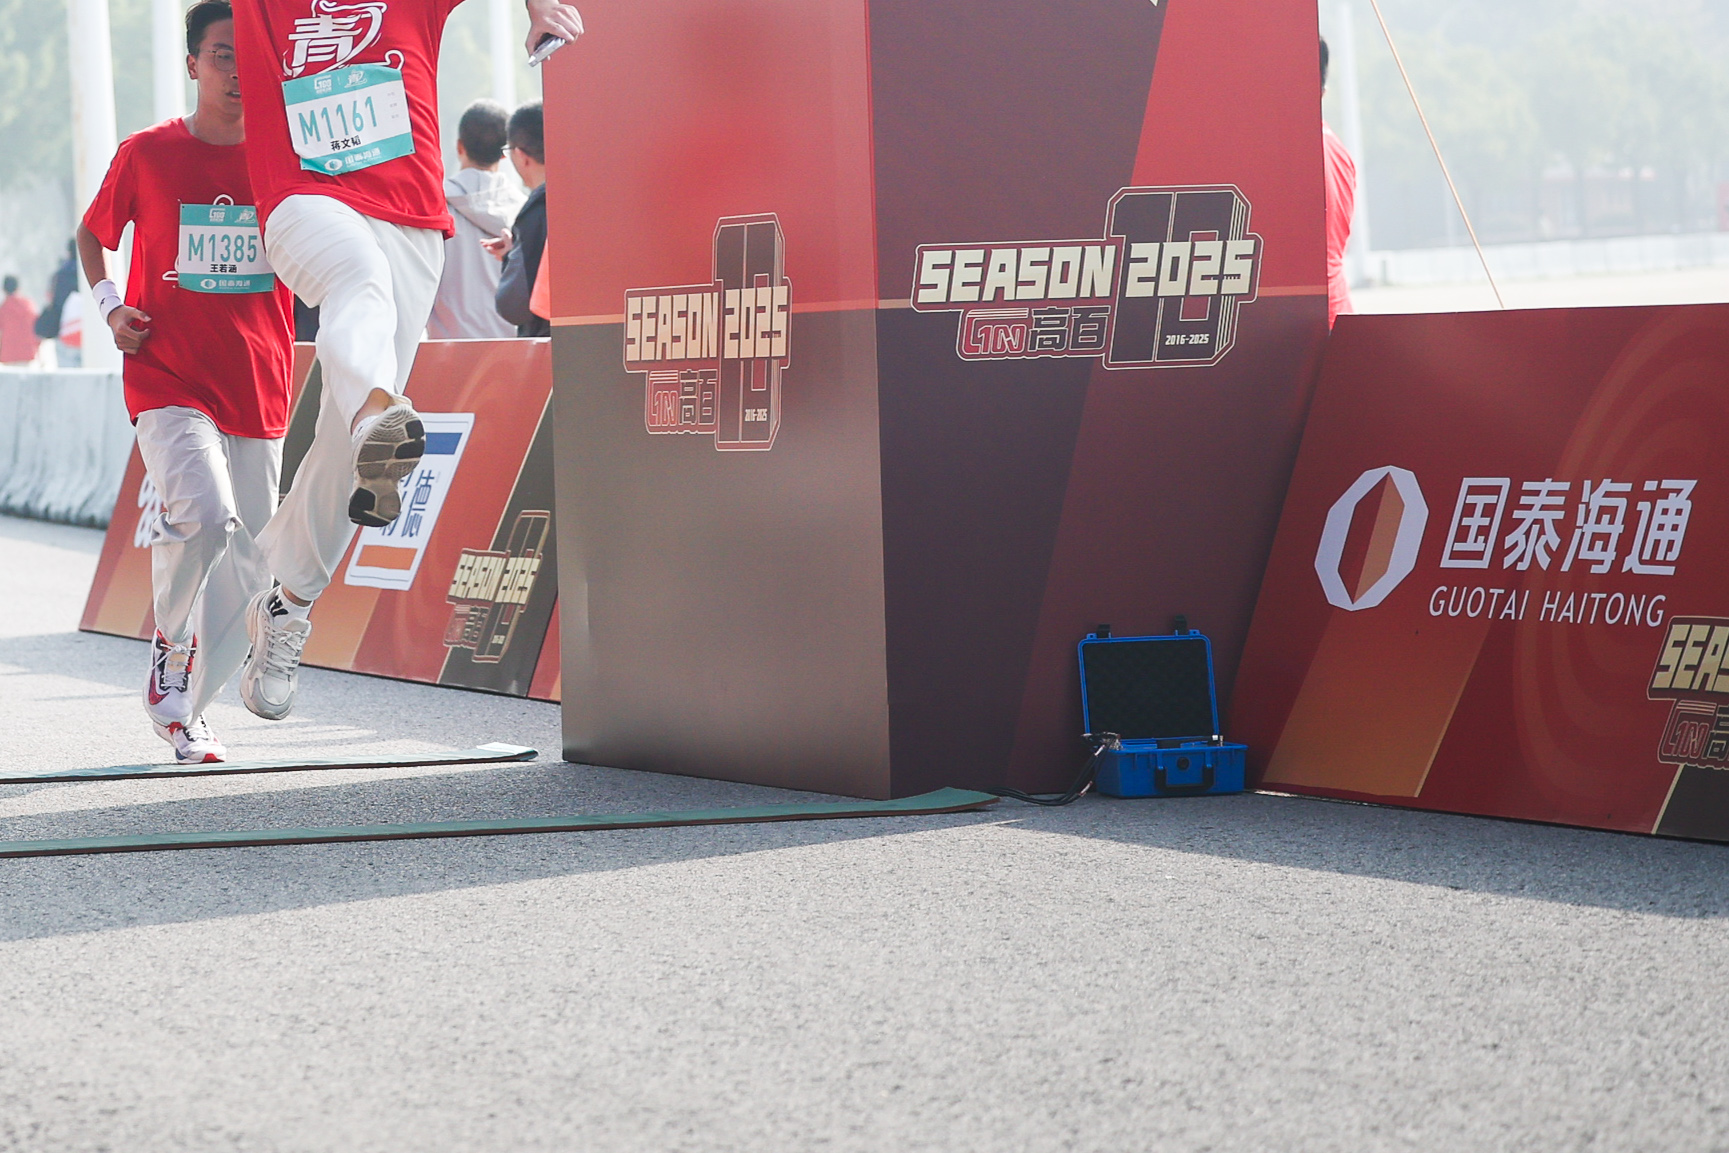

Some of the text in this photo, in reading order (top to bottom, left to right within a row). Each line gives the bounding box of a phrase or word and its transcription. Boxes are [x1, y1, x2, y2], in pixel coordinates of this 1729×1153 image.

[298, 95, 377, 145] M1161
[188, 233, 257, 263] M1385
[918, 239, 1255, 303] SEASON 2025
[626, 285, 788, 362] SEASON 2025
[1029, 305, 1111, 353] 高百
[1165, 333, 1210, 346] 2016-2025
[678, 369, 718, 425] 高百
[1439, 476, 1699, 576] 国泰海通
[447, 553, 541, 605] SEASON 2025
[1428, 585, 1667, 627] GUOTAI HAITONG
